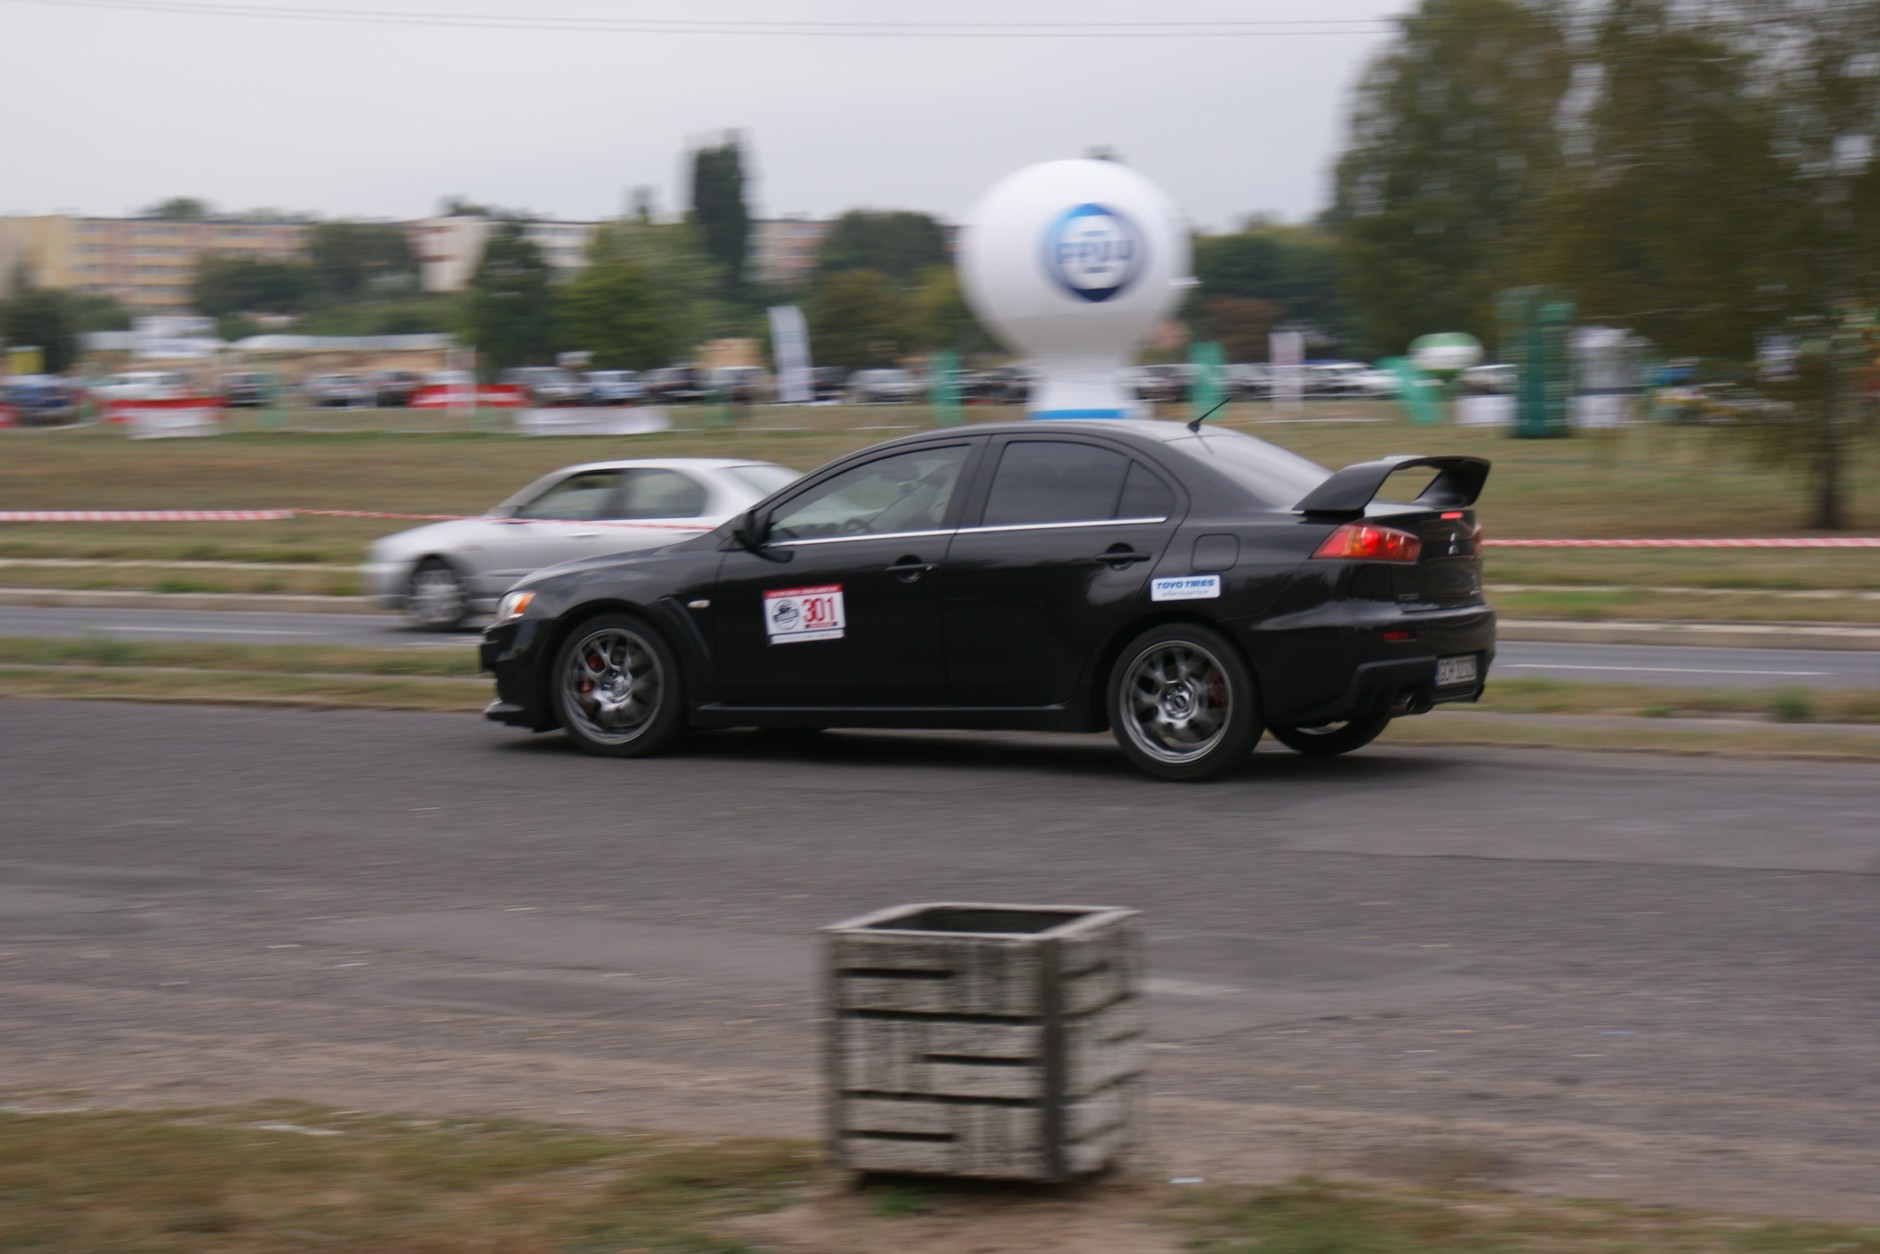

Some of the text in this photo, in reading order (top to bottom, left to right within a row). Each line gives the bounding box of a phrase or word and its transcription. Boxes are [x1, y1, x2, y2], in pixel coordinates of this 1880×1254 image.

[1156, 579, 1215, 590] TOYO TIRES
[802, 596, 836, 622] 301
